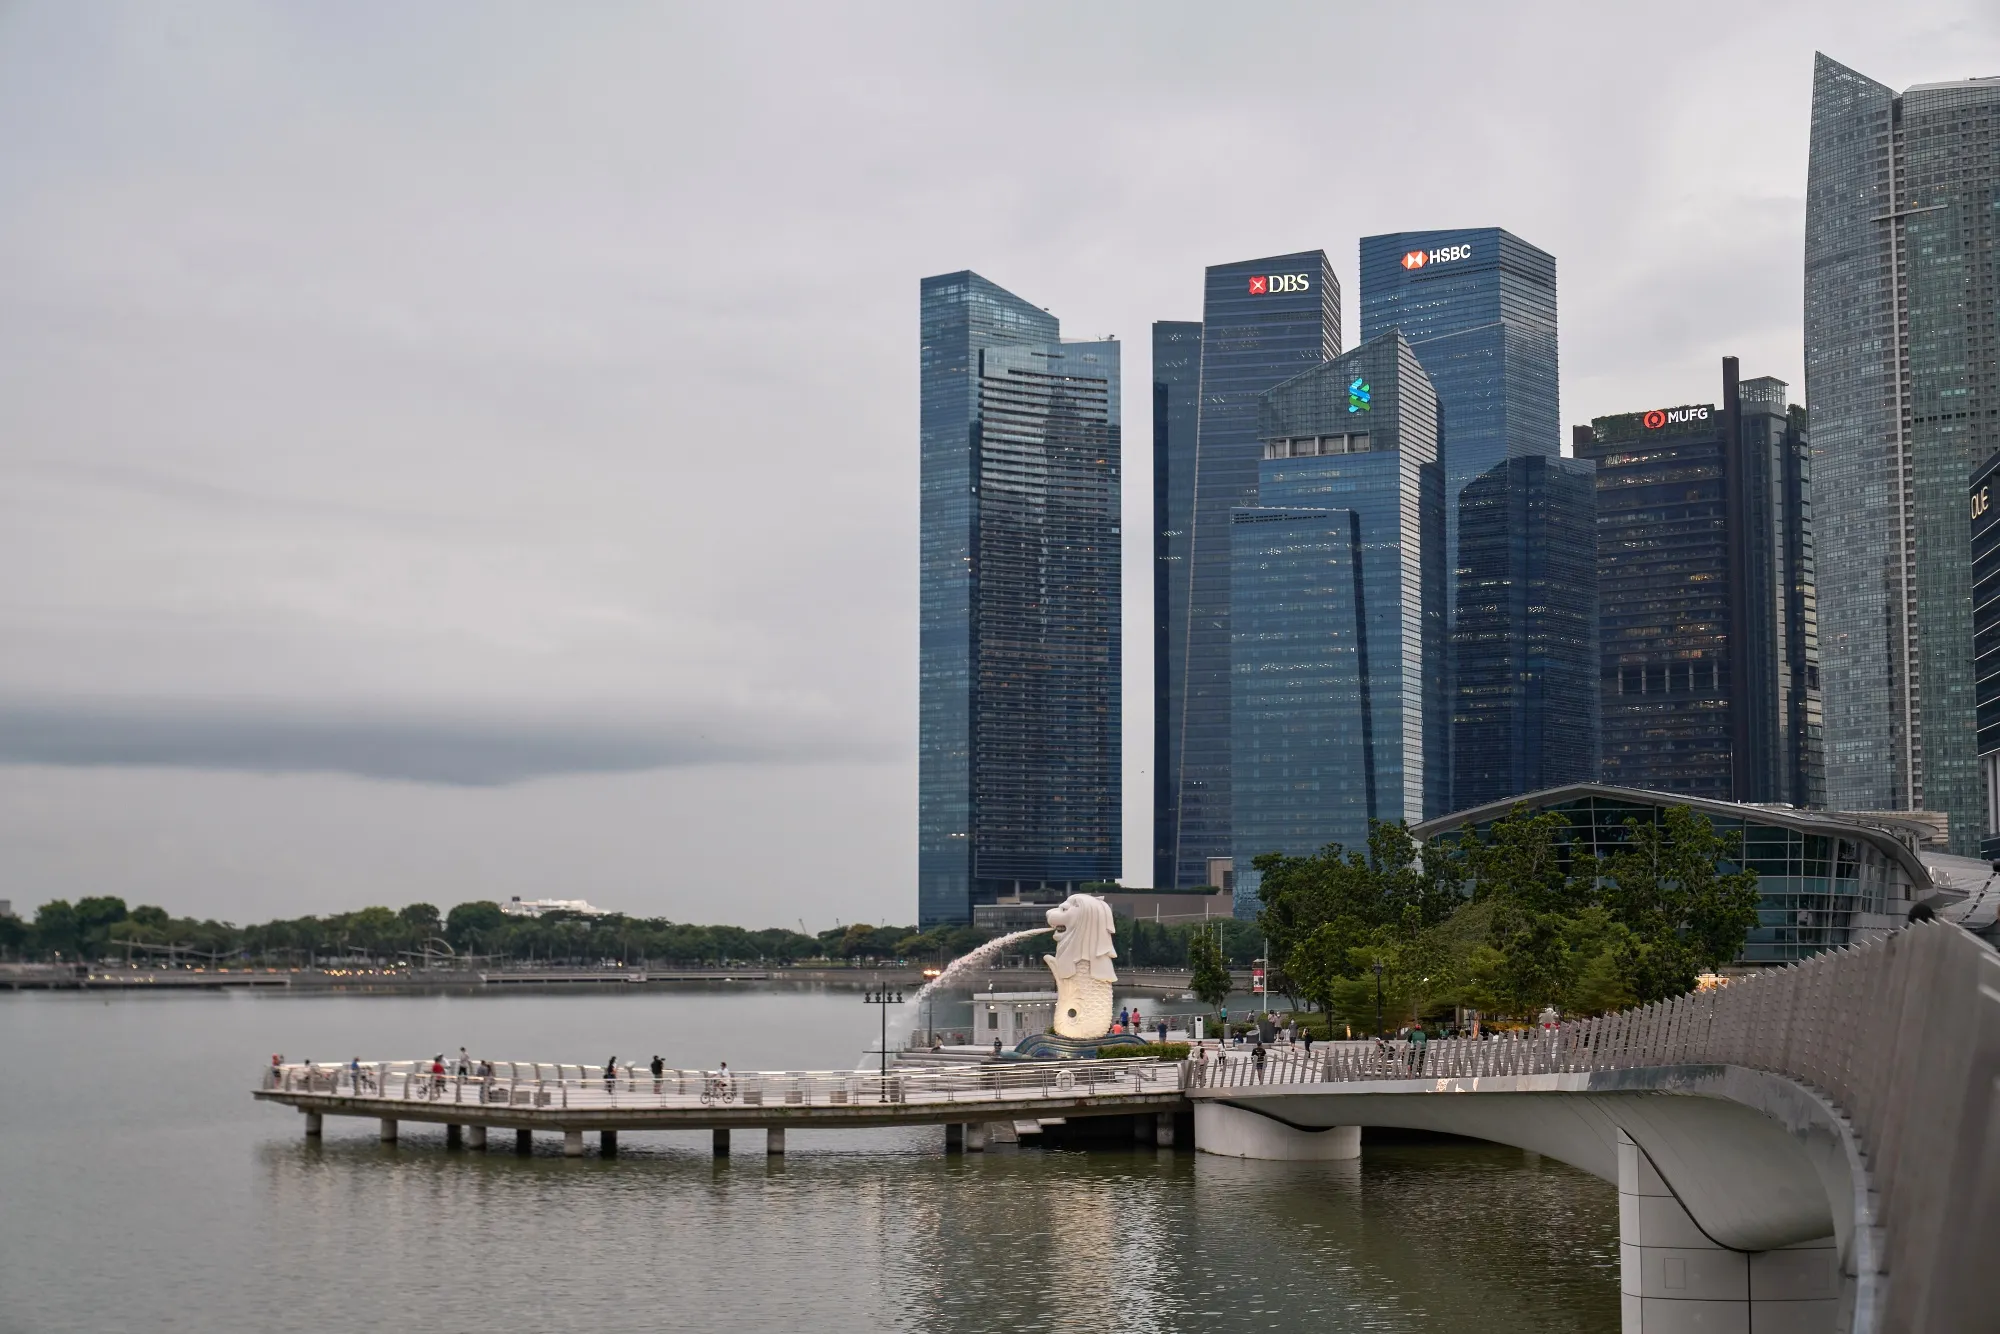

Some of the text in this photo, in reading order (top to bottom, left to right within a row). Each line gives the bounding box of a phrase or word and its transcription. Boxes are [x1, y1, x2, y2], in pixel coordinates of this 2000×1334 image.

[1429, 244, 1471, 264] HSBC
[1268, 273, 1310, 293] DBS
[1668, 407, 1708, 424] MUFG
[1971, 486, 1989, 519] OUE
